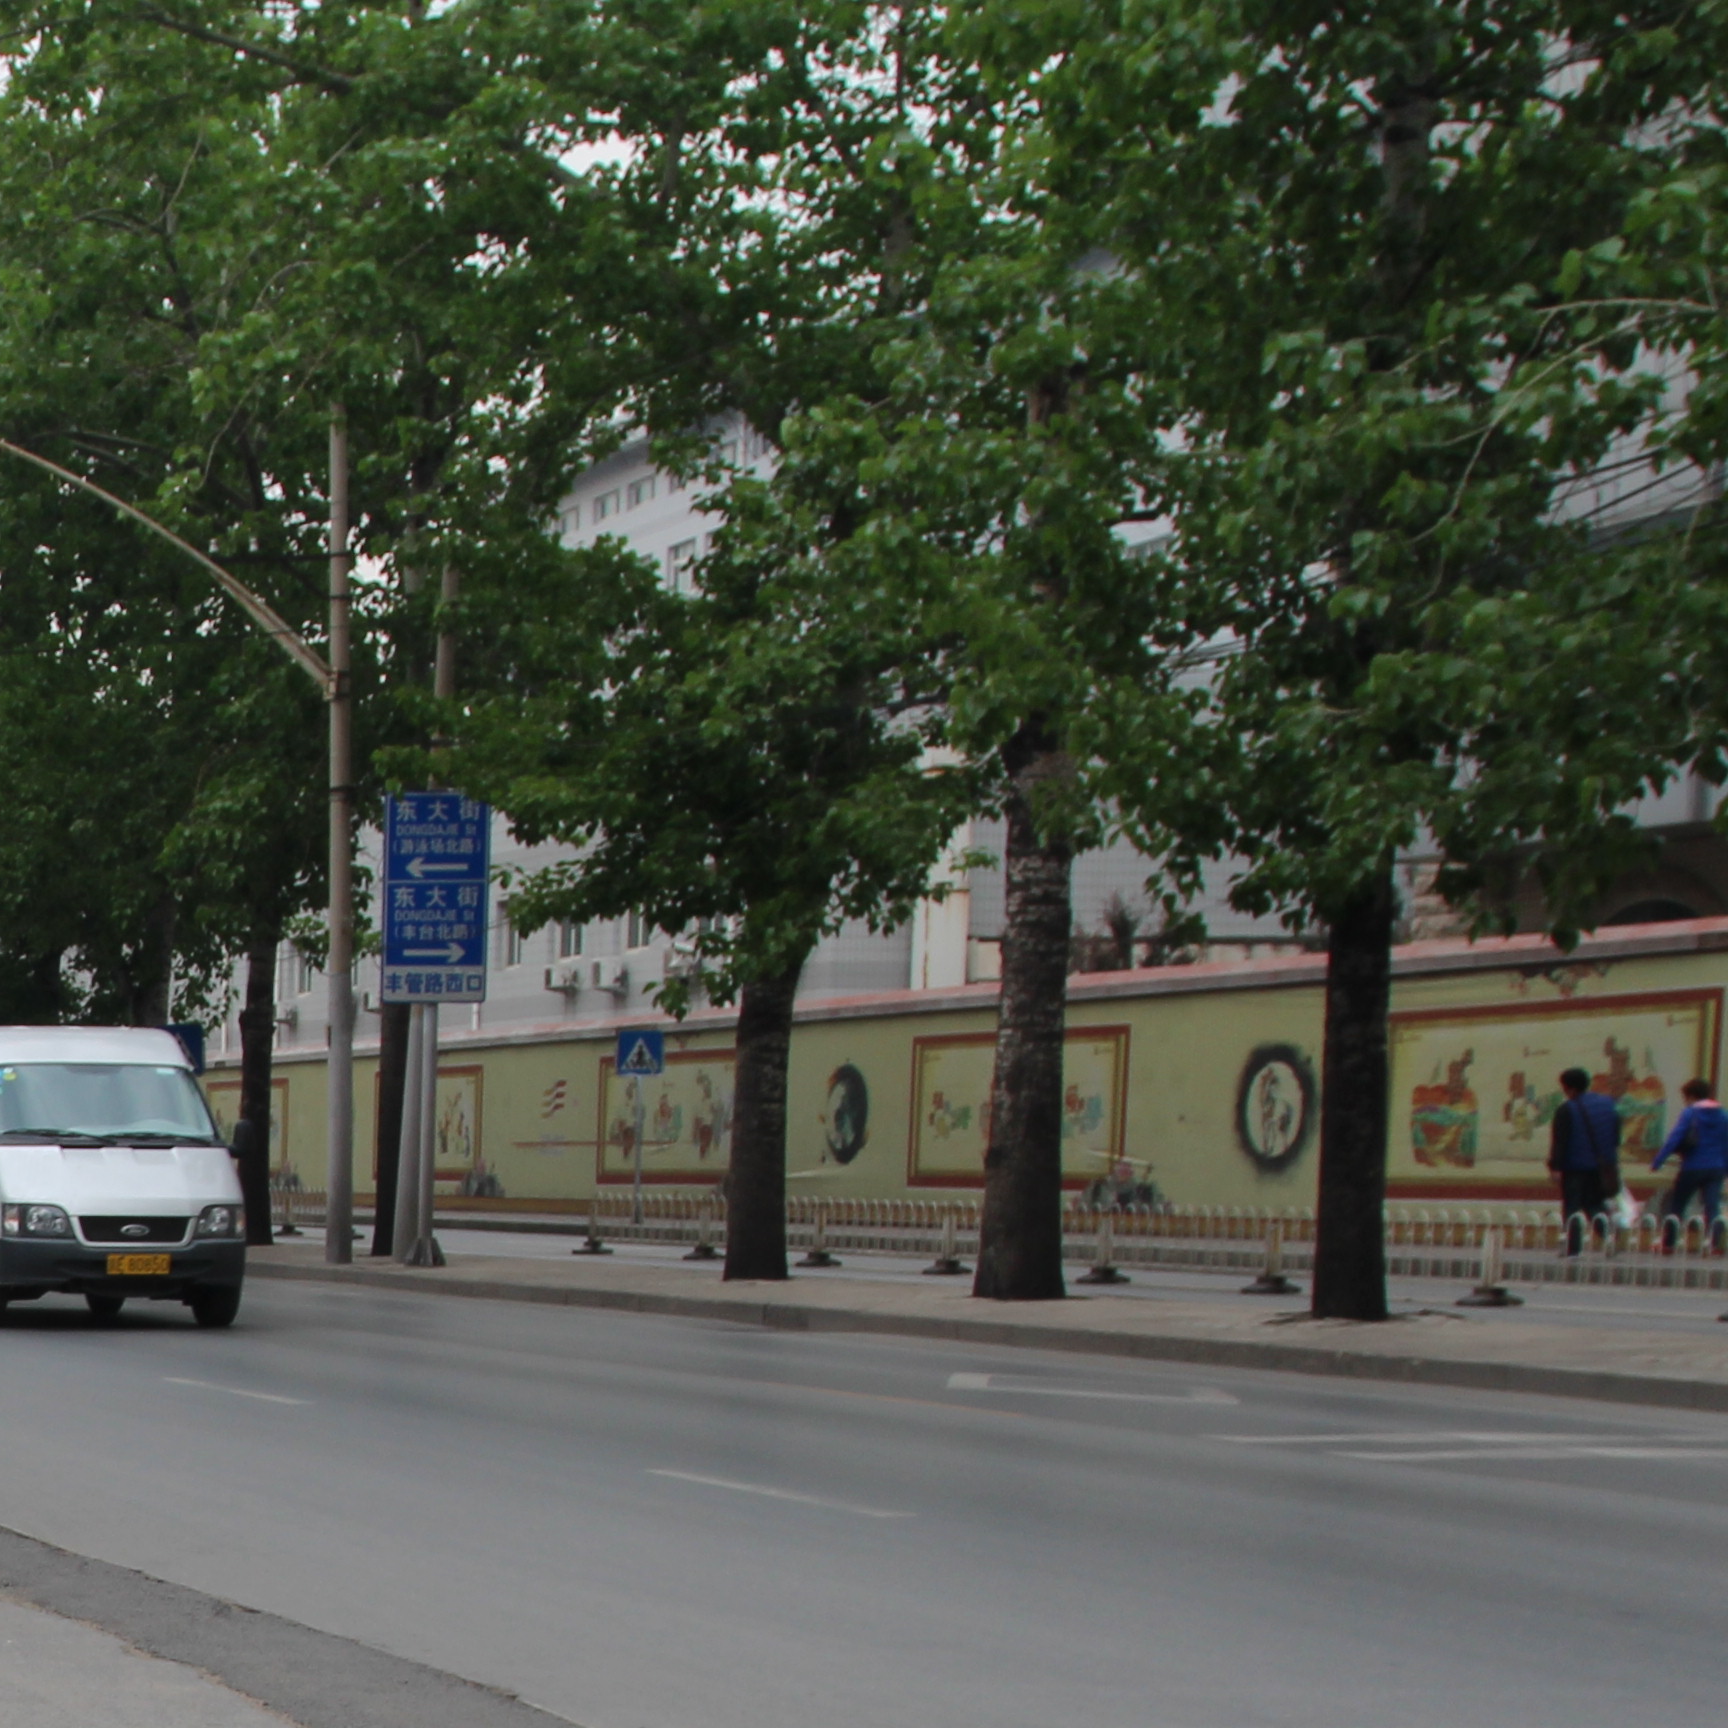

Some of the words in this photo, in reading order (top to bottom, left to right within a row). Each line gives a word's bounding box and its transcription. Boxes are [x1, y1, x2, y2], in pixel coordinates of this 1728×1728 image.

[396, 800, 480, 821] 东大街
[393, 886, 479, 908] 东大街
